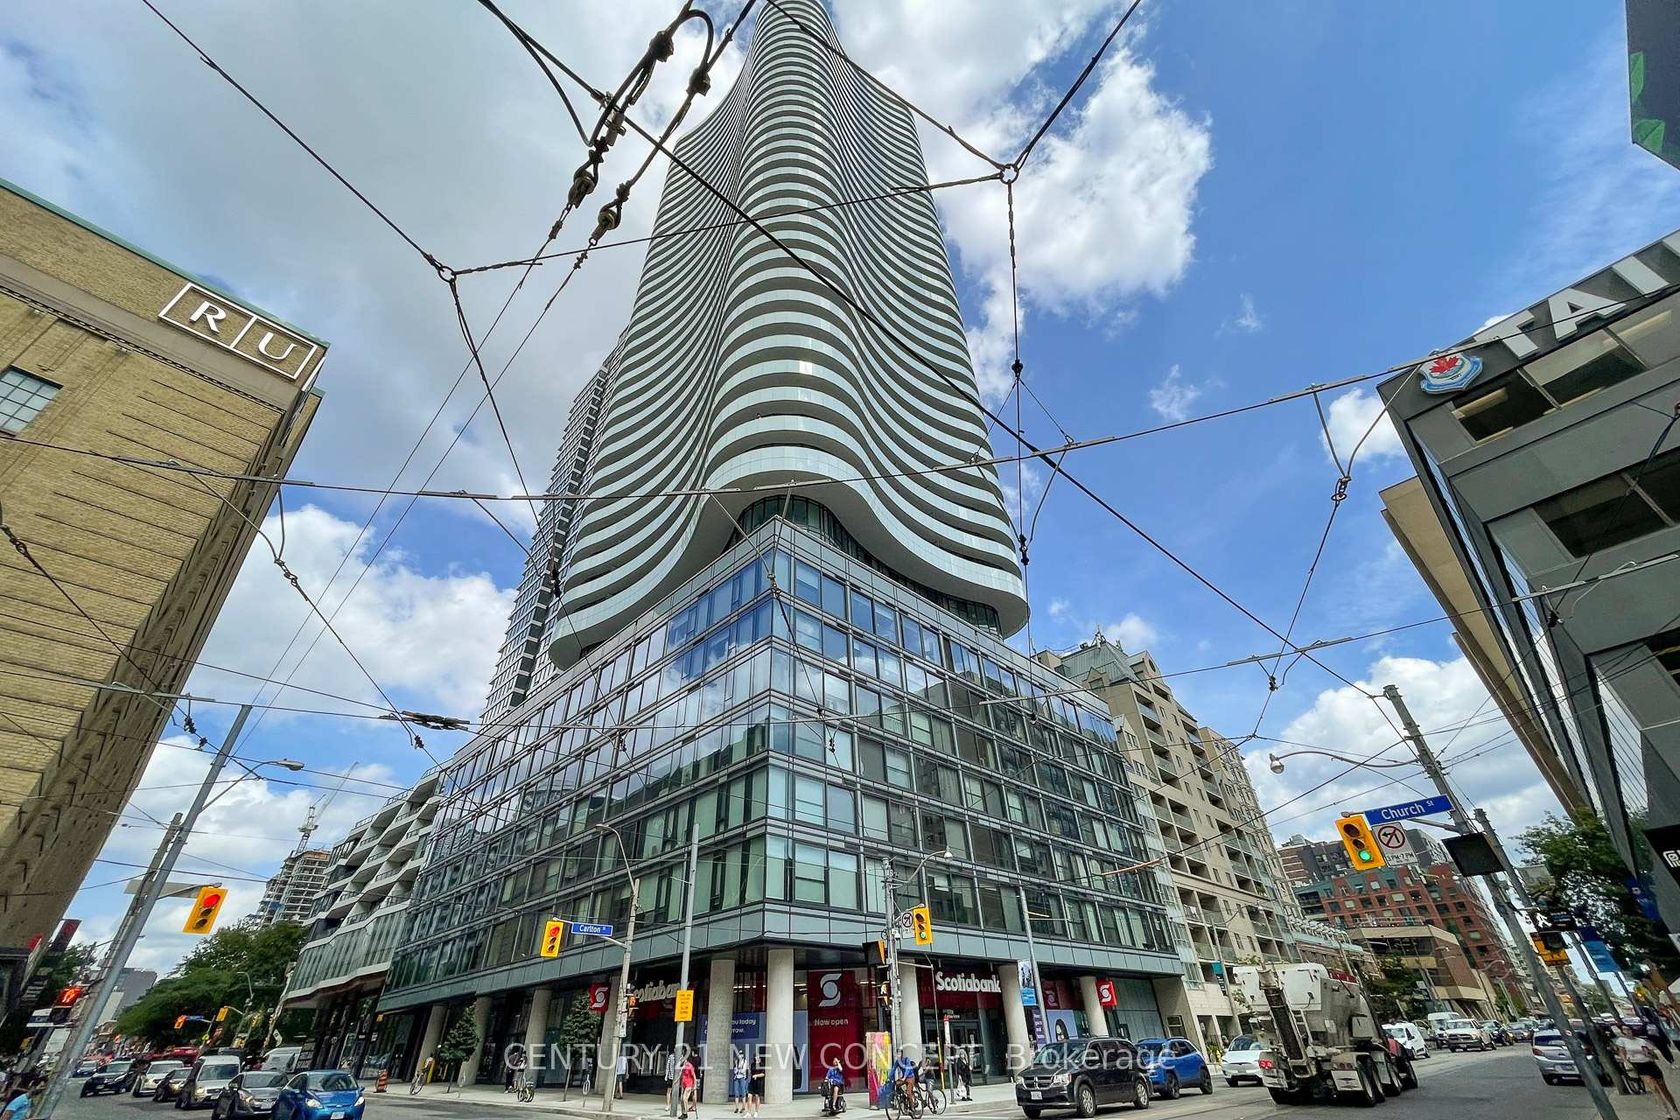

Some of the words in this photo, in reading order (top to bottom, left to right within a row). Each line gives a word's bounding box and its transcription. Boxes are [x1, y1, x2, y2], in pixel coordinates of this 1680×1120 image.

[1381, 803, 1426, 820] Church
[1426, 800, 1434, 808] St
[579, 924, 601, 933] Carlton
[935, 971, 1002, 993] Scotiabank
[814, 1018, 830, 1026] Now
[830, 1018, 849, 1027] open
